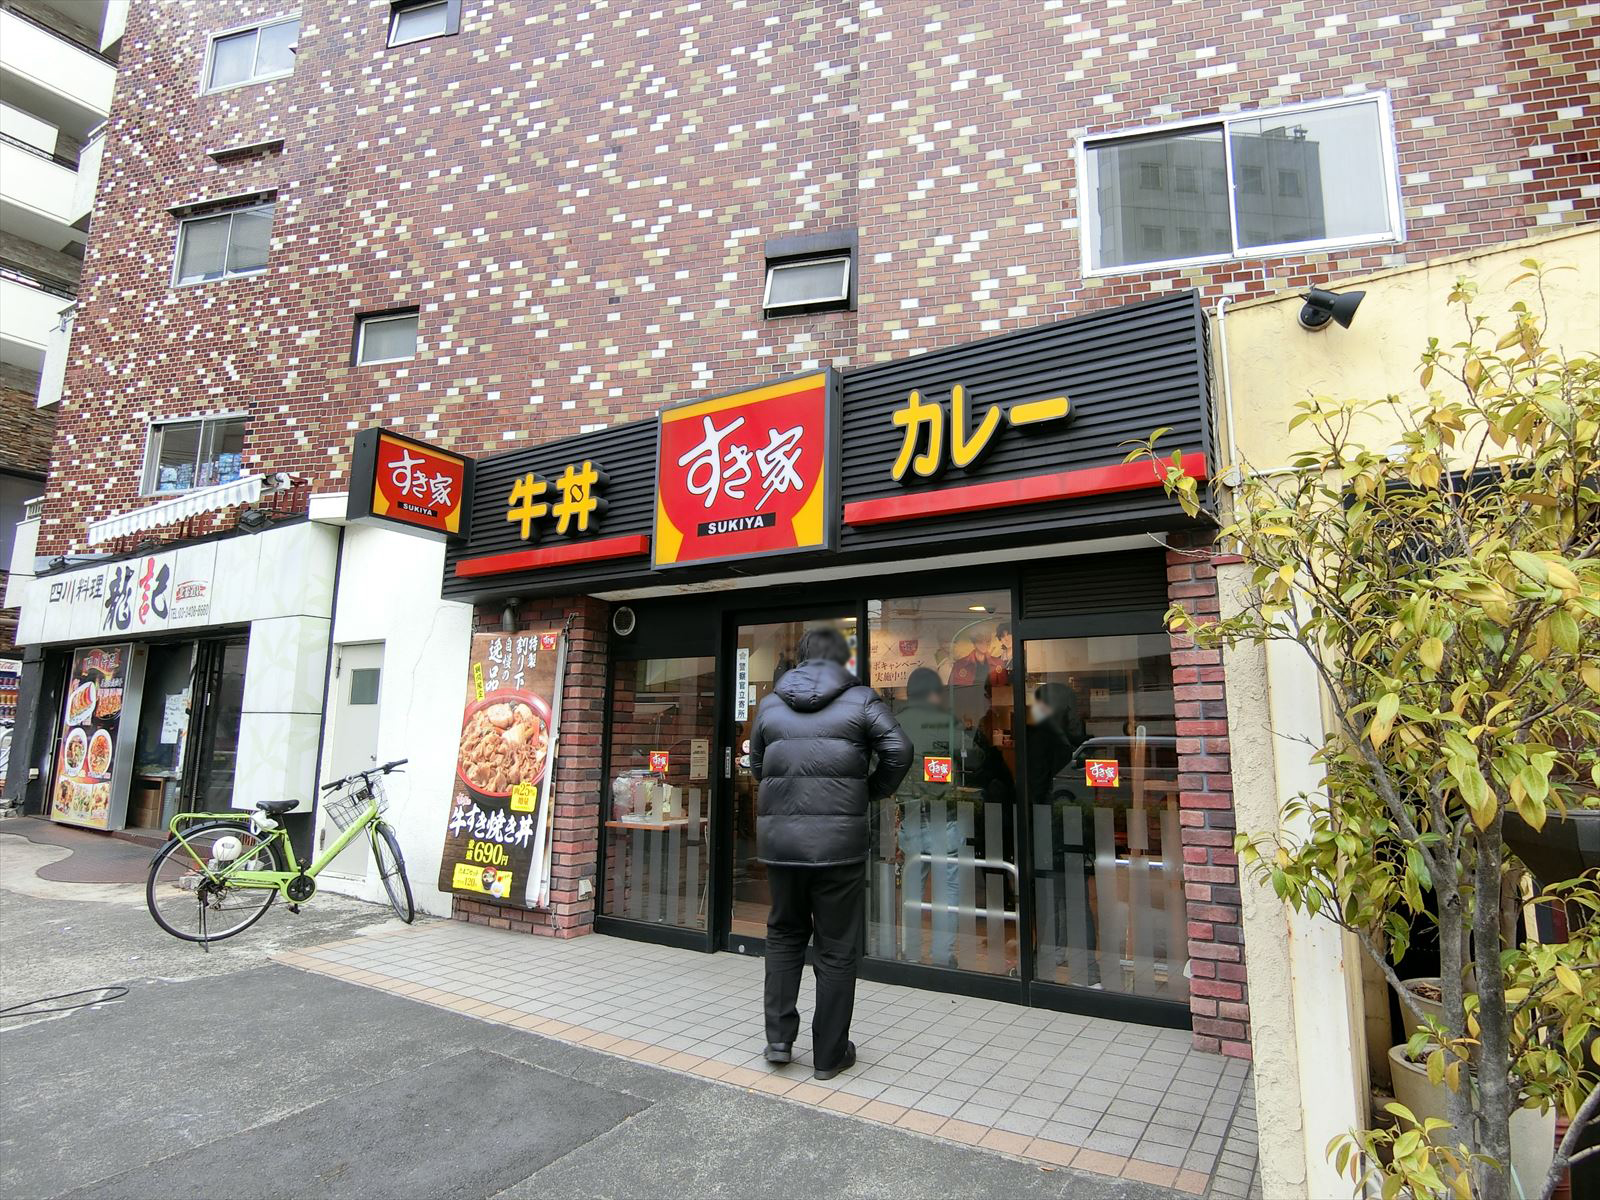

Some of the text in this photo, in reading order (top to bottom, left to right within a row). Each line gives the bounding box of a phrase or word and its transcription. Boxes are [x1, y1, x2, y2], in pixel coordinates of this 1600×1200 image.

[891, 384, 1071, 483] カレー
[388, 449, 452, 507] すき家
[677, 415, 804, 511] すき家
[402, 503, 433, 516] SUKIYA
[506, 460, 599, 541] 牛丼
[707, 515, 764, 534] SUKIYA
[49, 575, 104, 603] 四川料理
[485, 637, 502, 692] 逸品
[502, 637, 513, 681] 自慢の
[514, 636, 529, 690] 割り下
[527, 635, 538, 668] 特製
[1090, 763, 1115, 779] すき家
[449, 803, 534, 848] 牛すき焼き丼
